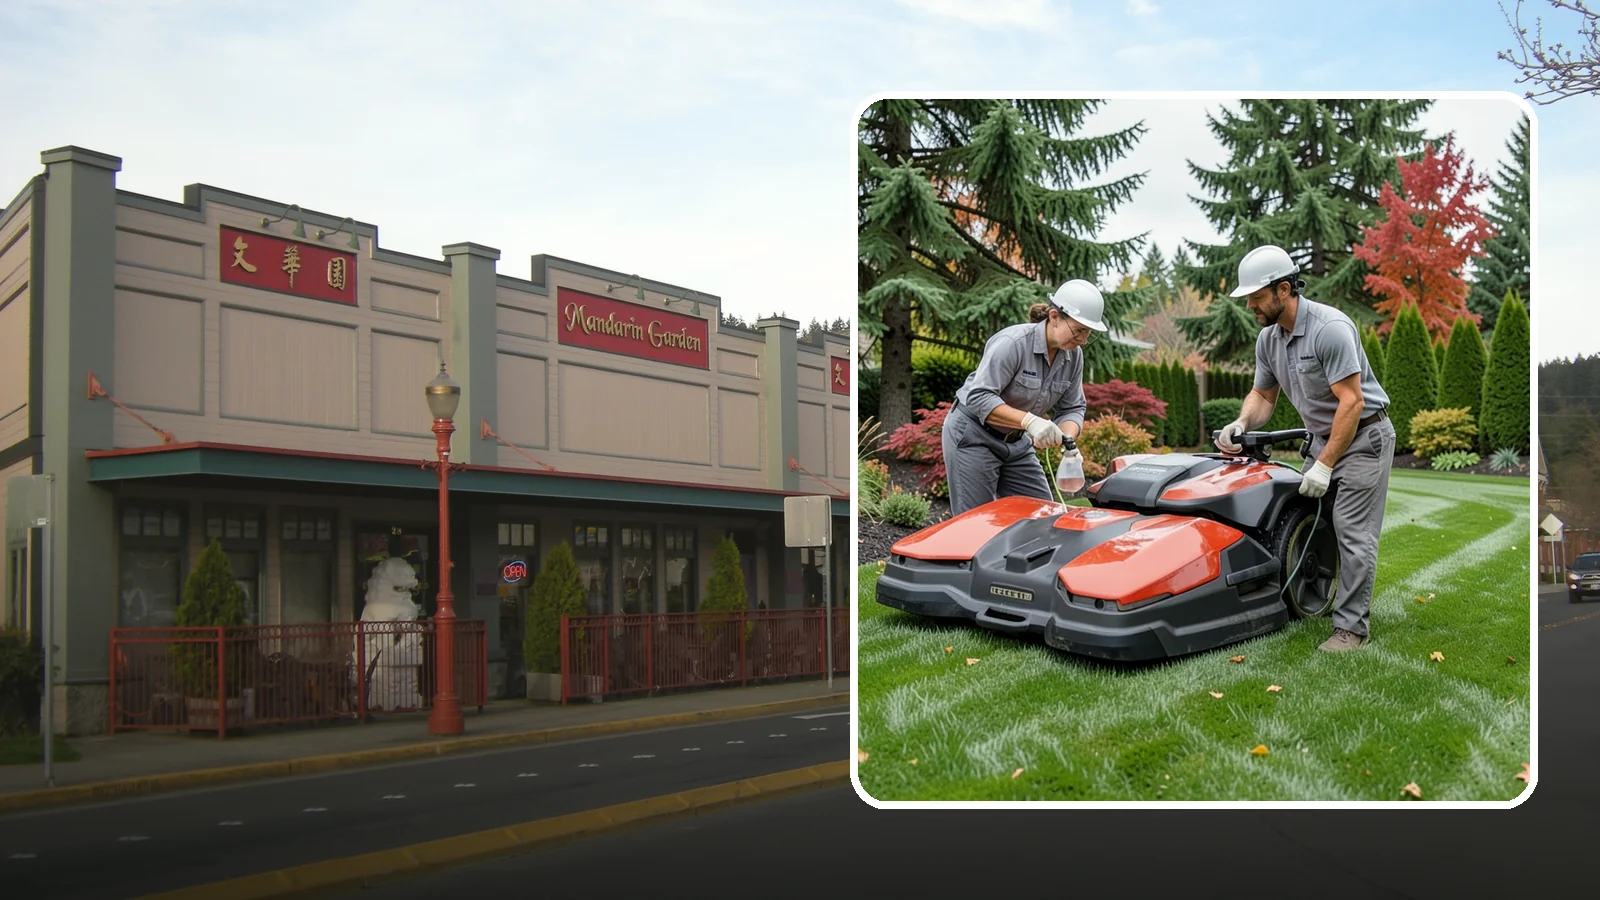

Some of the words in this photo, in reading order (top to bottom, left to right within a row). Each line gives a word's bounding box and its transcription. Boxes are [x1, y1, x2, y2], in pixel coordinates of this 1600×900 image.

[231, 235, 345, 290] 文華園
[564, 302, 643, 341] Mandarin
[648, 320, 701, 352] Garden
[834, 363, 846, 386] 文
[503, 565, 527, 578] OPEN
